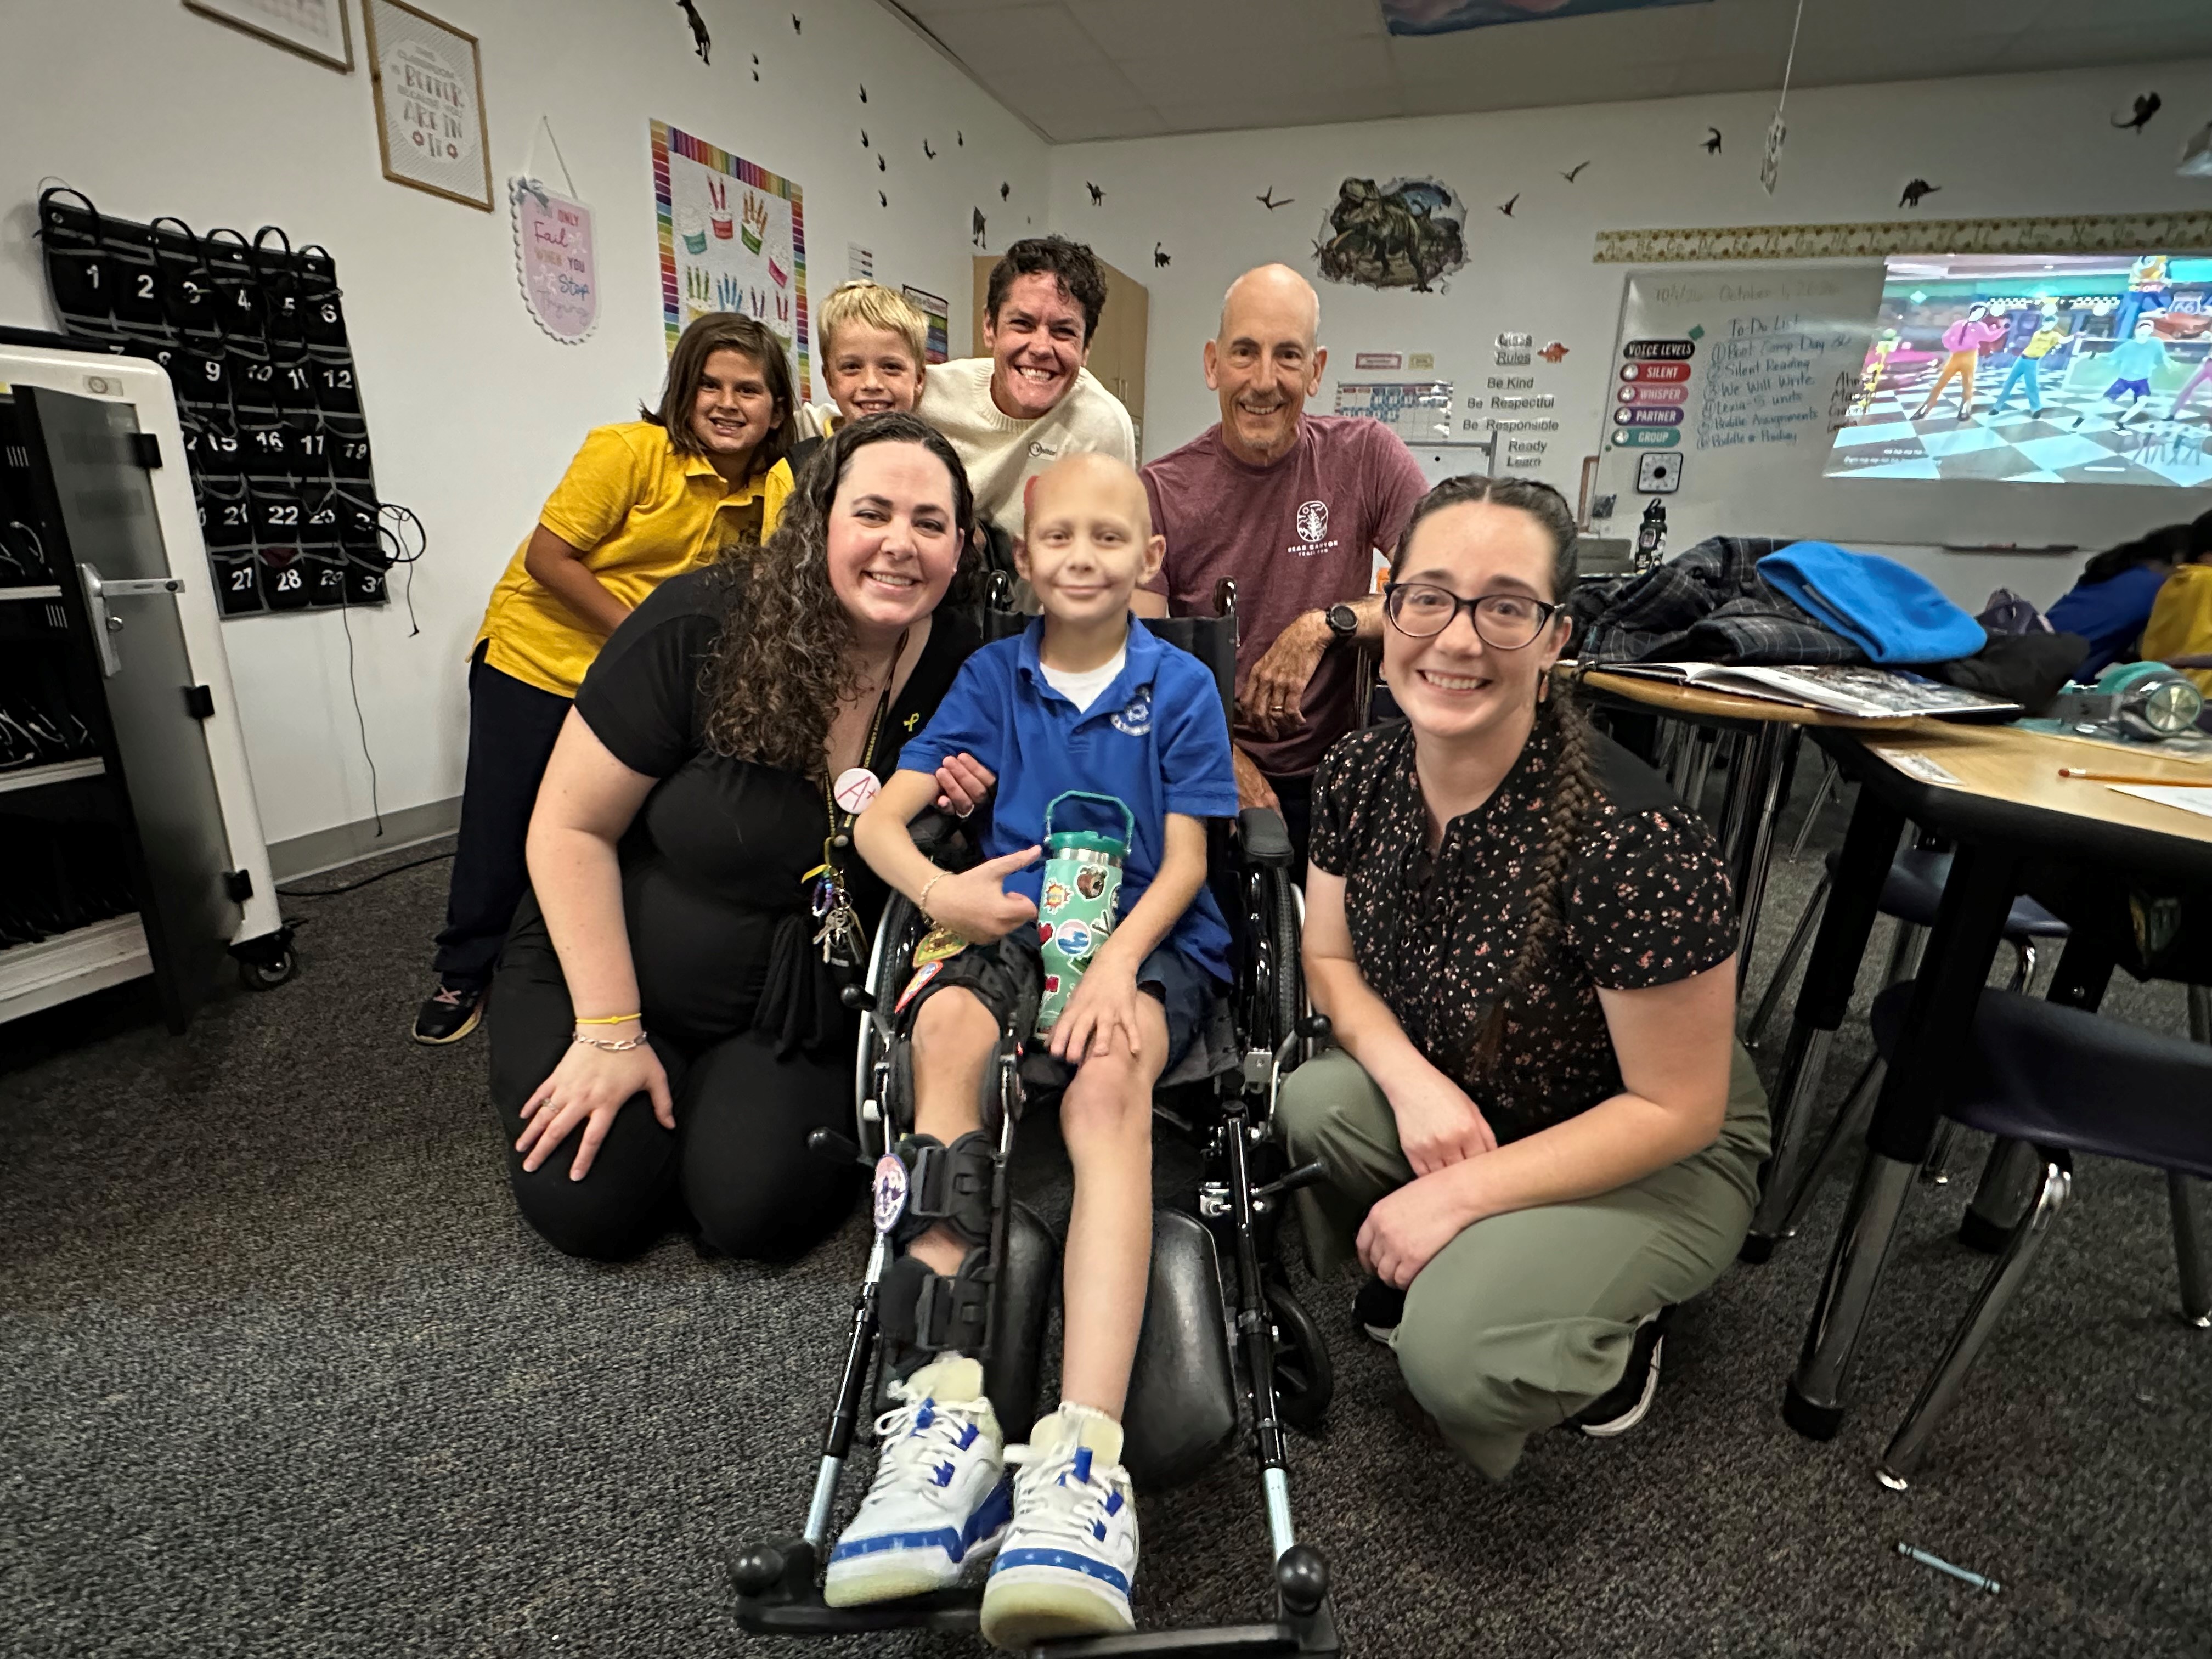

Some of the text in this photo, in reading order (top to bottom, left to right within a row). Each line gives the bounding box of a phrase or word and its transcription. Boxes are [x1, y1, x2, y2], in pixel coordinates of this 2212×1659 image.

[534, 221, 568, 247] Fail
[86, 264, 337, 323] 1 2 3 4 5 6
[1629, 343, 1691, 356] VOICE LEVELS
[1496, 351, 1531, 365] Rules
[205, 361, 220, 381] 9
[287, 368, 309, 390] 11
[323, 369, 352, 389] 12
[1646, 366, 1678, 379] SILENT
[1487, 377, 1534, 389] Be Kind
[1640, 388, 1681, 400] WHISPER
[1468, 396, 1554, 410] Be Respectful
[1636, 410, 1677, 422] PARTNER
[1463, 419, 1559, 432] Be Responsible
[256, 432, 283, 453] 16
[1638, 432, 1669, 443] GROUP
[1508, 439, 1547, 453] Ready
[223, 503, 248, 525] 21
[268, 506, 298, 525] 22
[232, 567, 252, 591] 27
[276, 569, 302, 591] 28
[837, 776, 876, 810] A+
